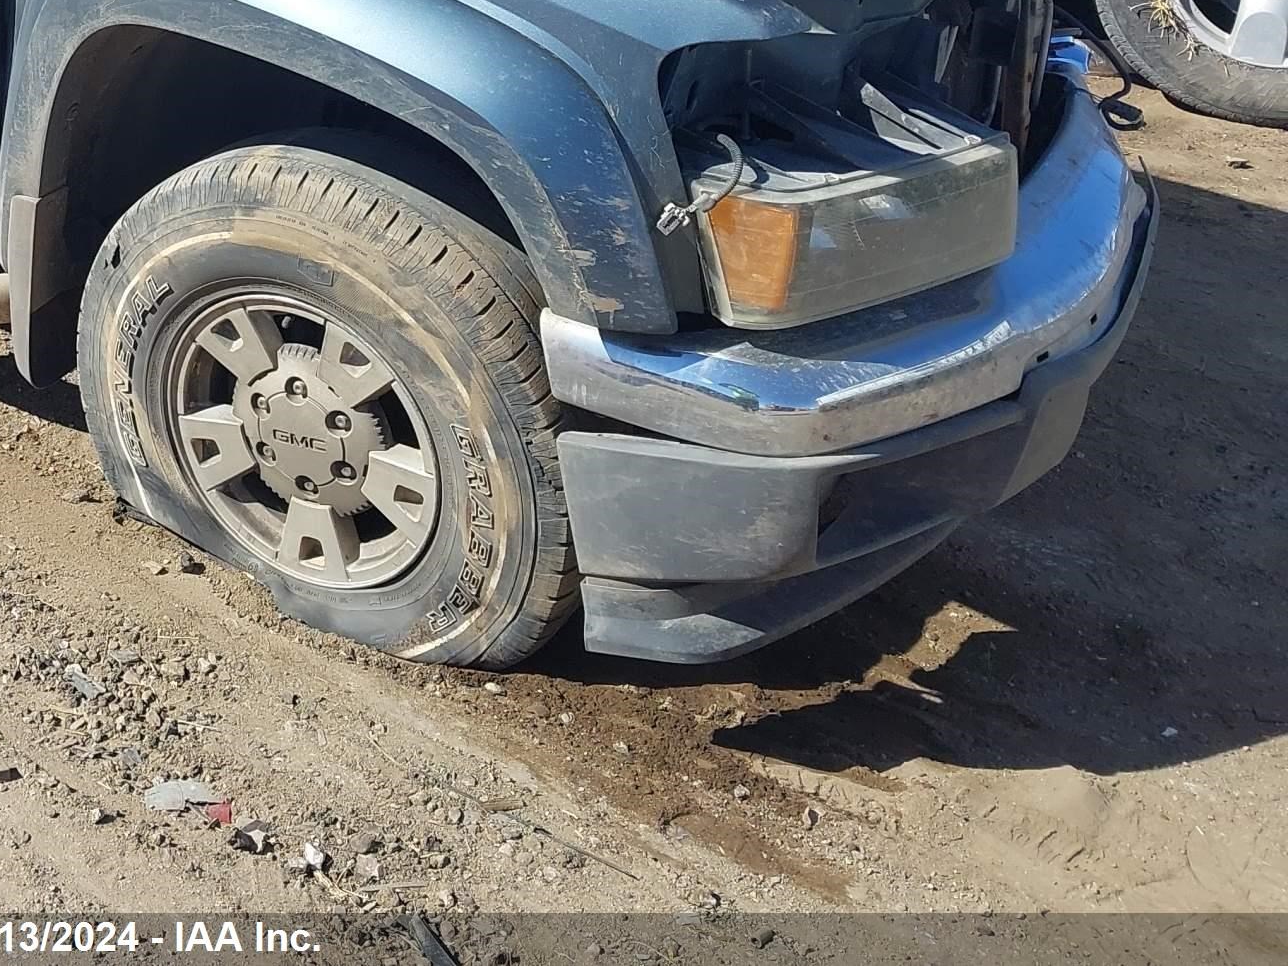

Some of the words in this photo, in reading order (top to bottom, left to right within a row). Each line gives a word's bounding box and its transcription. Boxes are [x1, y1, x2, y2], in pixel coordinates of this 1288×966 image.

[113, 275, 175, 468] GENERAL
[272, 428, 328, 454] GMC
[426, 423, 495, 636] GRABBER
